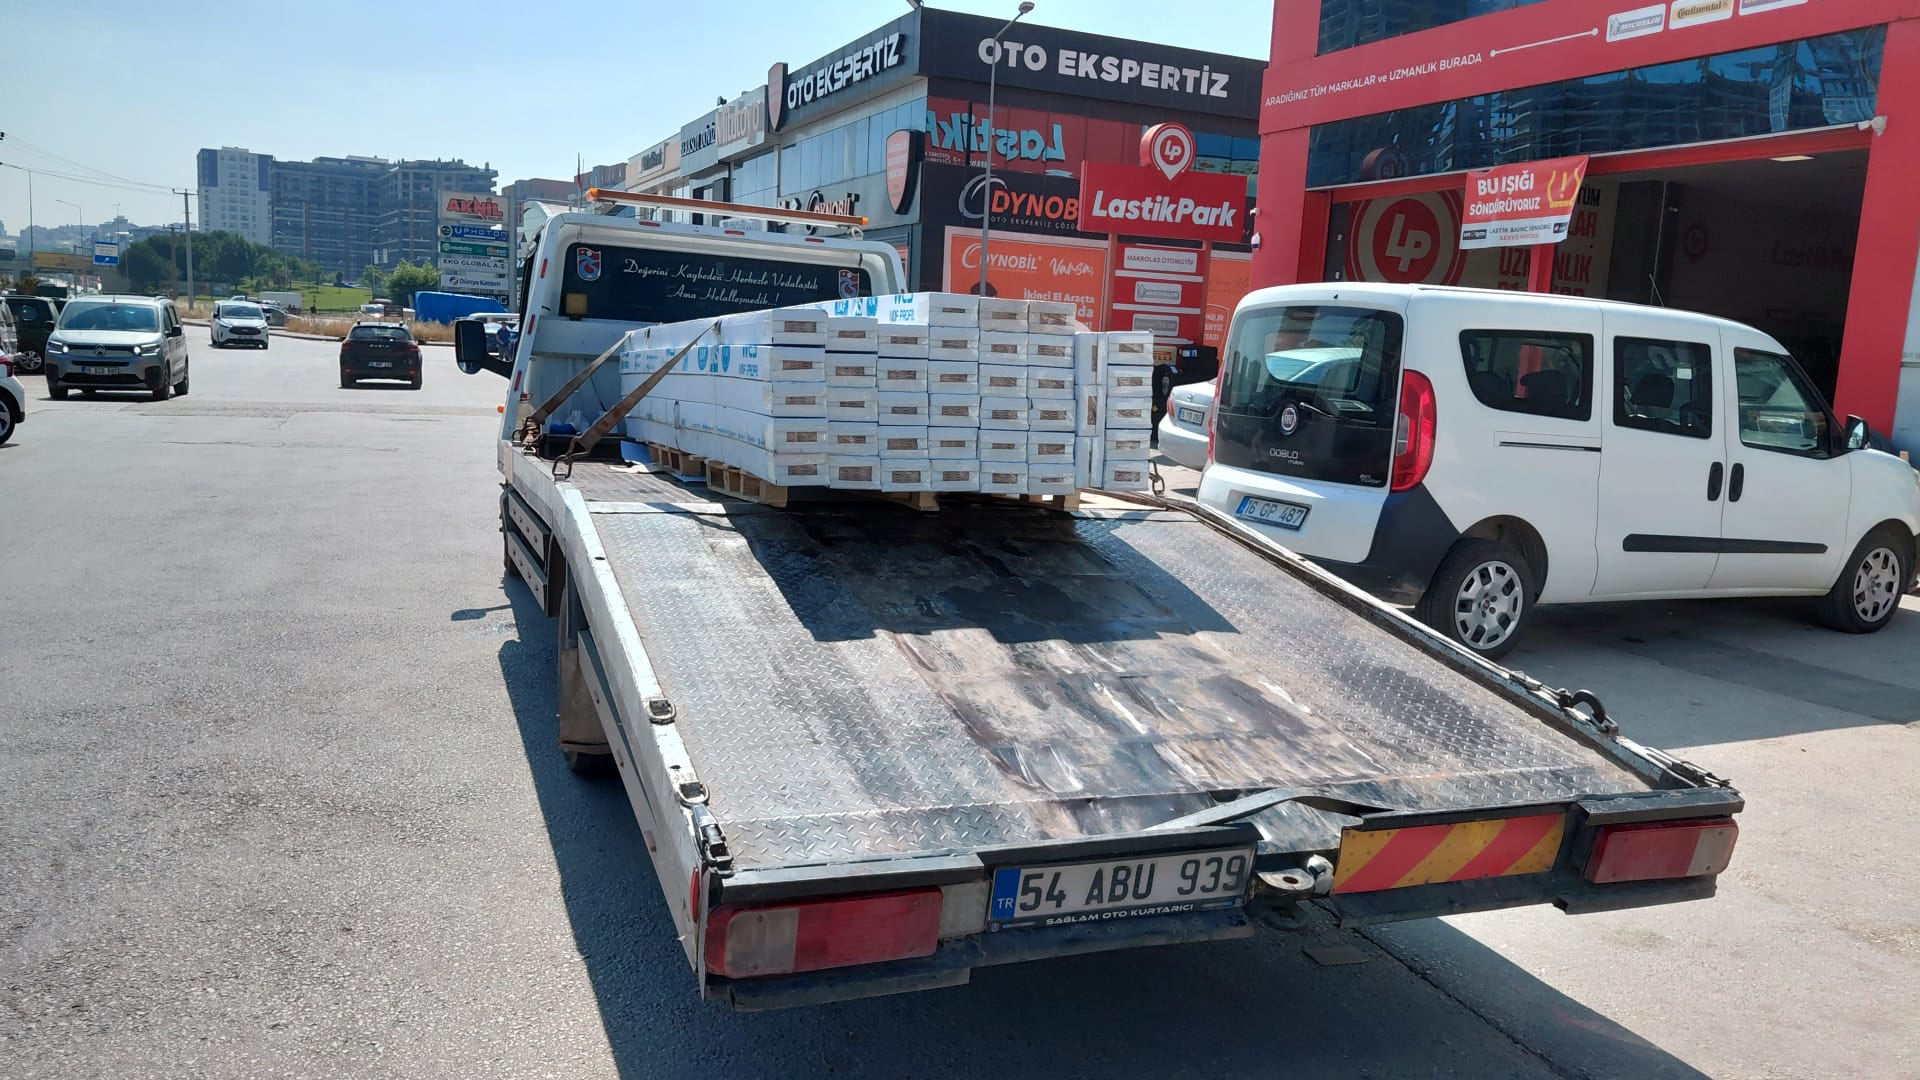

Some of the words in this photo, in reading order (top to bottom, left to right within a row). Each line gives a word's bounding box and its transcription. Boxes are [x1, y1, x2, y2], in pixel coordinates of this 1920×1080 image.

[1679, 1, 1730, 21] Continental
[1620, 15, 1662, 30] MICHELIN
[978, 37, 1048, 71] OTO
[1058, 48, 1230, 98] EKSPERTİZ
[1265, 88, 1308, 107] ARADIĞINIZ
[1310, 84, 1327, 97] TÜM
[1328, 74, 1376, 93] MARKALAR
[1377, 75, 1388, 83] ve
[1389, 61, 1437, 81] UZMANLIK
[1439, 52, 1482, 71] BURADA
[788, 74, 814, 109] OTO
[1164, 139, 1182, 161] LP
[1478, 179, 1498, 196] BU
[1501, 170, 1535, 195] IŞIĞI
[992, 190, 1079, 221] DYNOB
[1092, 190, 1237, 228] LastikPark
[1469, 197, 1541, 216] SÖNDÜRÜYORUZ
[990, 215, 1007, 224] OTO
[1010, 217, 1052, 229] EKSPERTİZ
[1385, 213, 1432, 273] LP
[443, 258, 459, 266] EKO
[460, 260, 490, 269] GLOBAL
[623, 258, 669, 278] Değerini
[671, 263, 722, 282] Kaybeden
[459, 278, 479, 287] Dünya
[667, 284, 697, 298] Ama
[1023, 287, 1051, 301] İkinci
[1269, 447, 1299, 460] DOBLO
[1245, 499, 1256, 514] 16
[1259, 502, 1278, 518] GP
[1280, 506, 1303, 523] 487
[1019, 871, 1067, 912] 54
[1085, 862, 1156, 906] ABU
[1177, 854, 1247, 896] 939
[997, 897, 1013, 909] TR
[1046, 913, 1099, 926] SAĞLAM
[1103, 909, 1128, 919] OTO
[1130, 903, 1194, 916] KURTARICI
